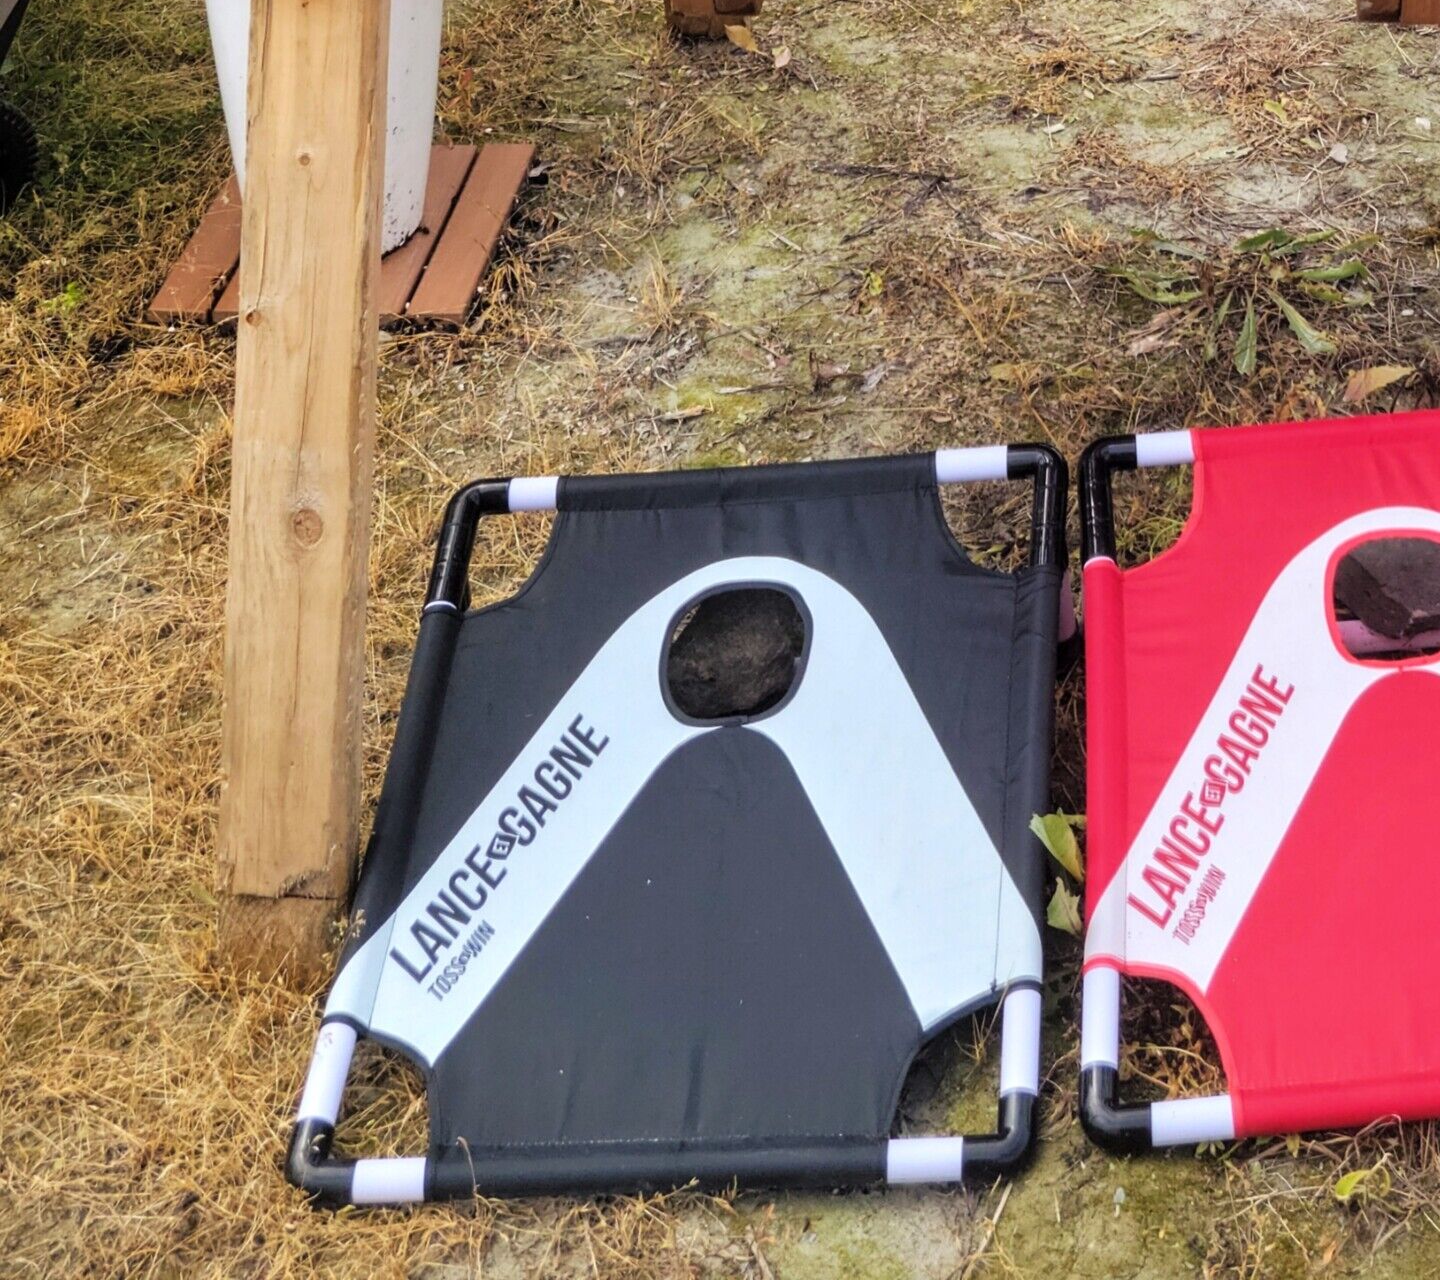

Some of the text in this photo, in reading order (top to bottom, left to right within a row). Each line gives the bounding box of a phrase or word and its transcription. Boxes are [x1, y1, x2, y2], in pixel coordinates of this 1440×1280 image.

[389, 844, 508, 984] LANCE
[498, 713, 610, 848] GAGNE
[1127, 791, 1225, 930] LANCE
[1203, 663, 1295, 795] GAGNE
[427, 956, 466, 1001] TOSS
[466, 919, 496, 958] WIN
[1172, 900, 1206, 946] TOSS
